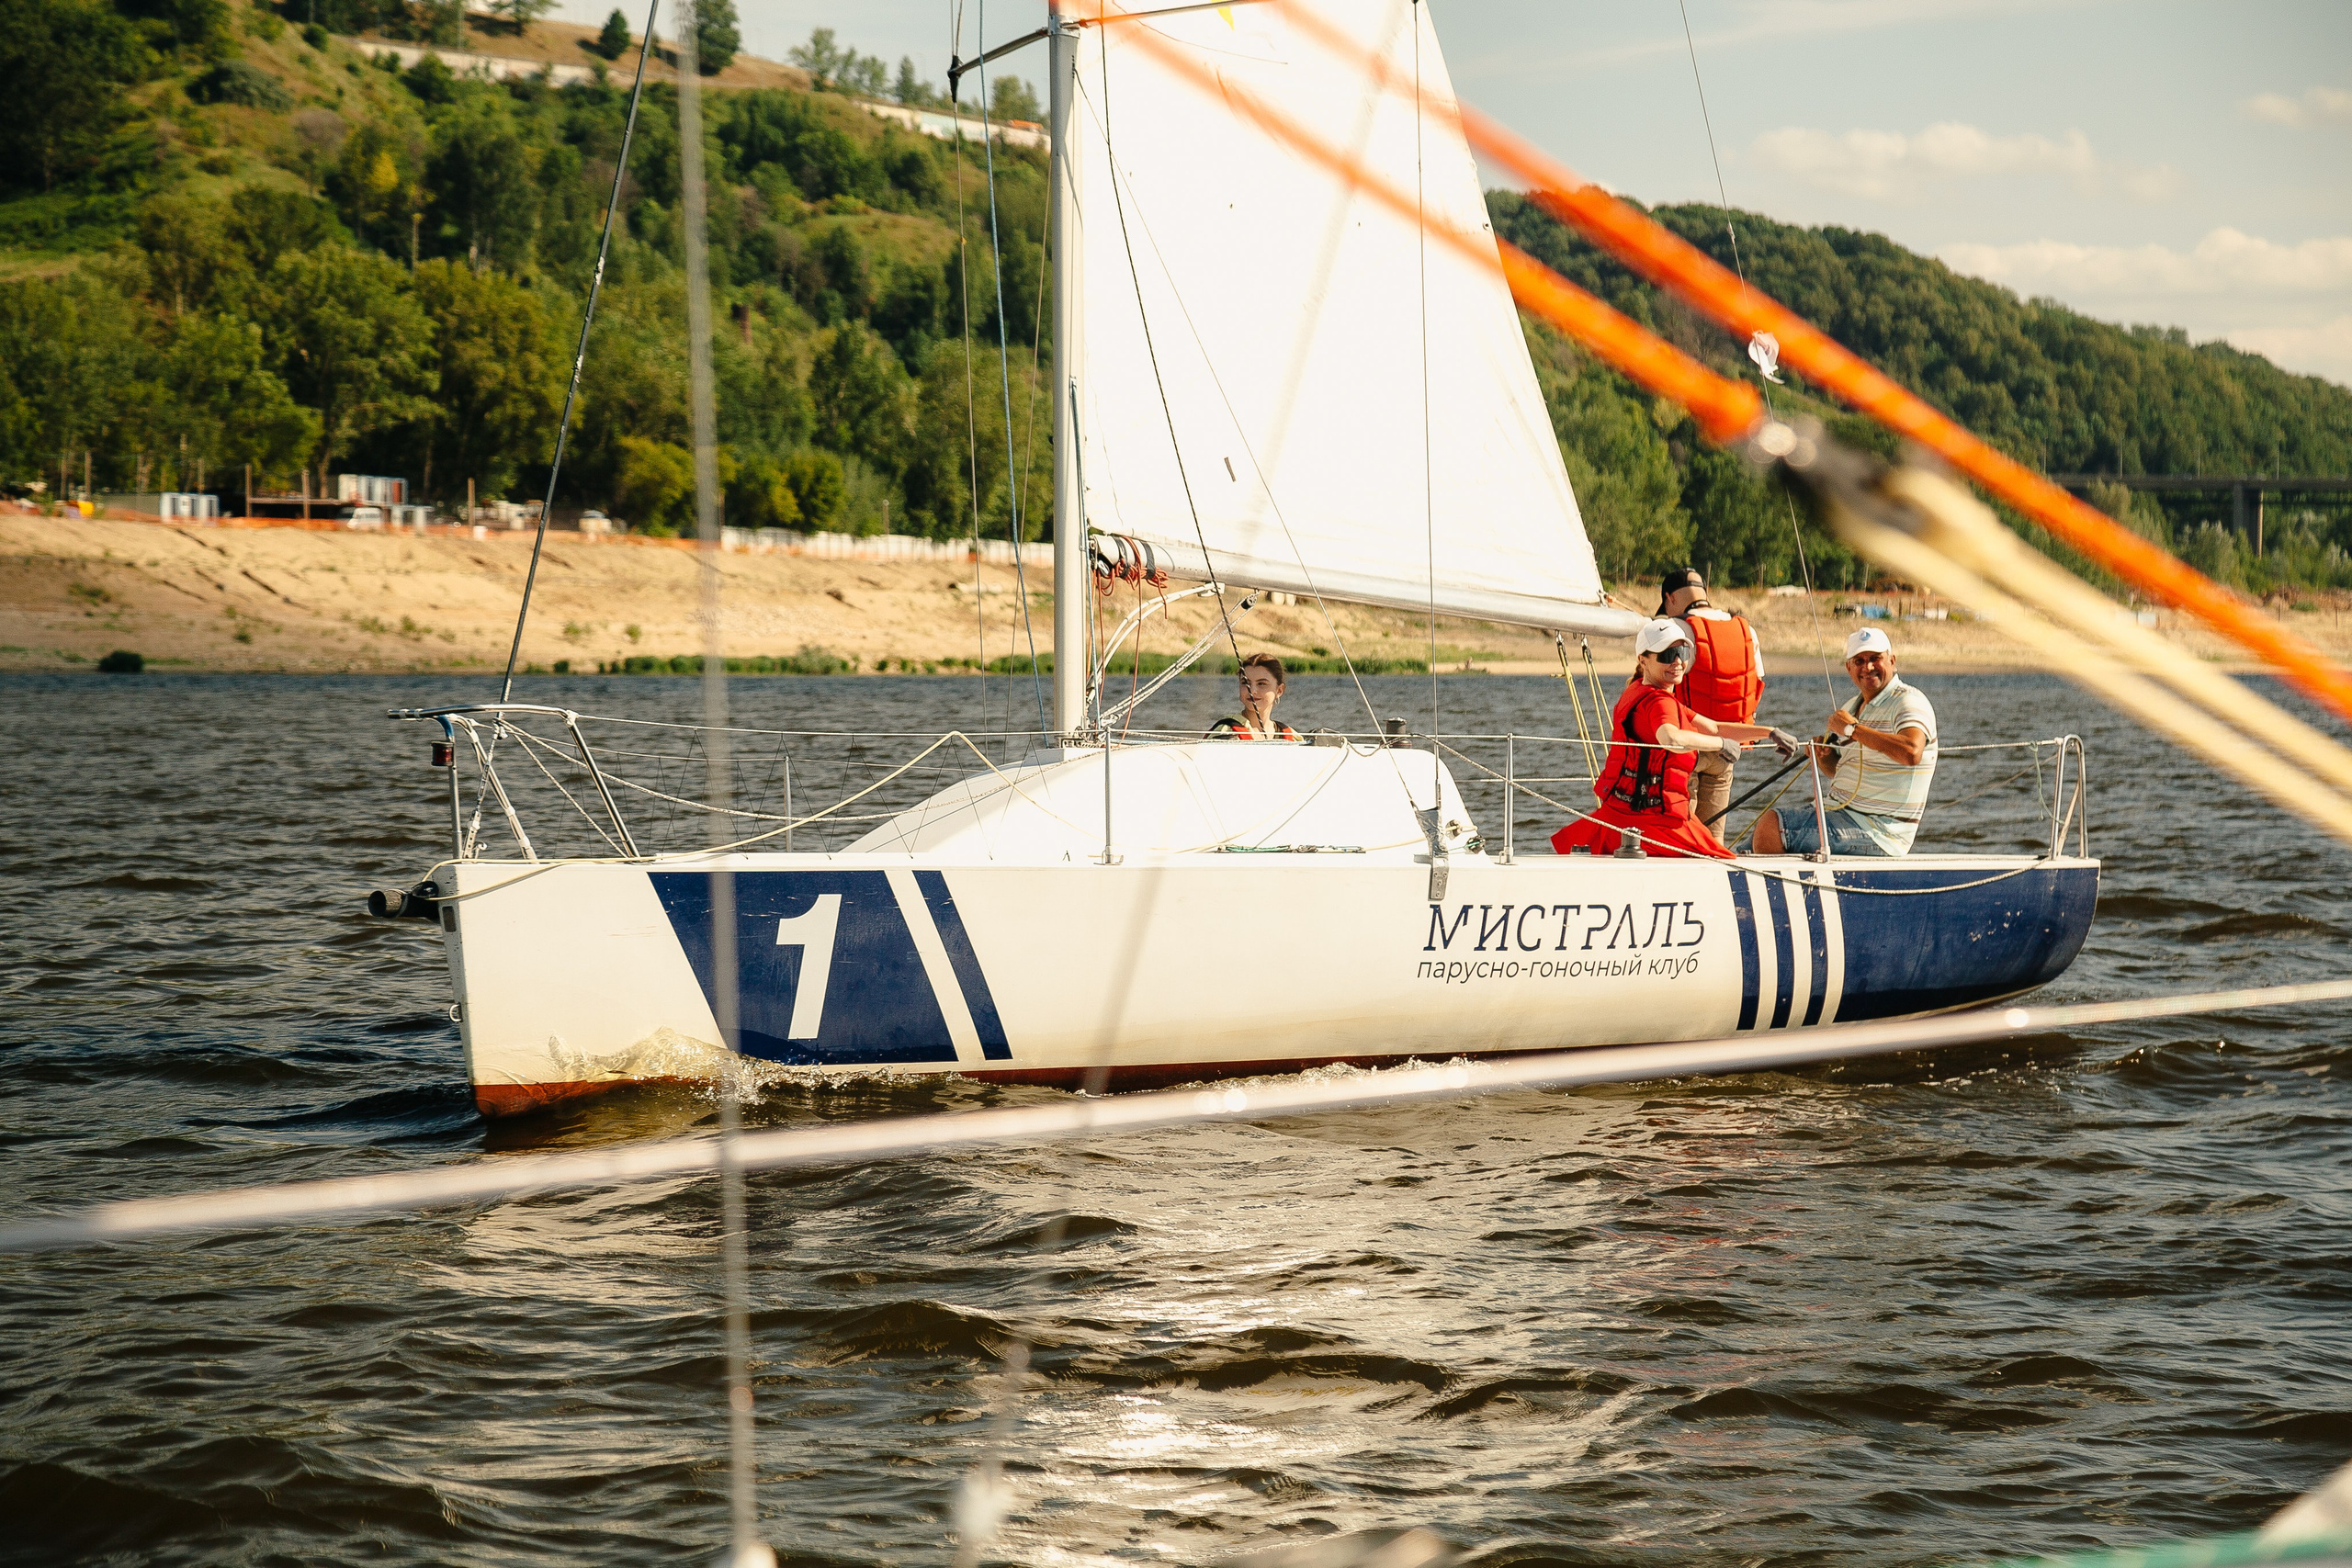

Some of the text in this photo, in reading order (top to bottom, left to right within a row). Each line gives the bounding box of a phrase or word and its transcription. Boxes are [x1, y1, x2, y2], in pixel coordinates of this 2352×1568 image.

[1422, 901, 1705, 952] МИСТРАЛЬ
[775, 893, 842, 1040] 1
[1417, 950, 1701, 985] парусно-гоночный клуб
